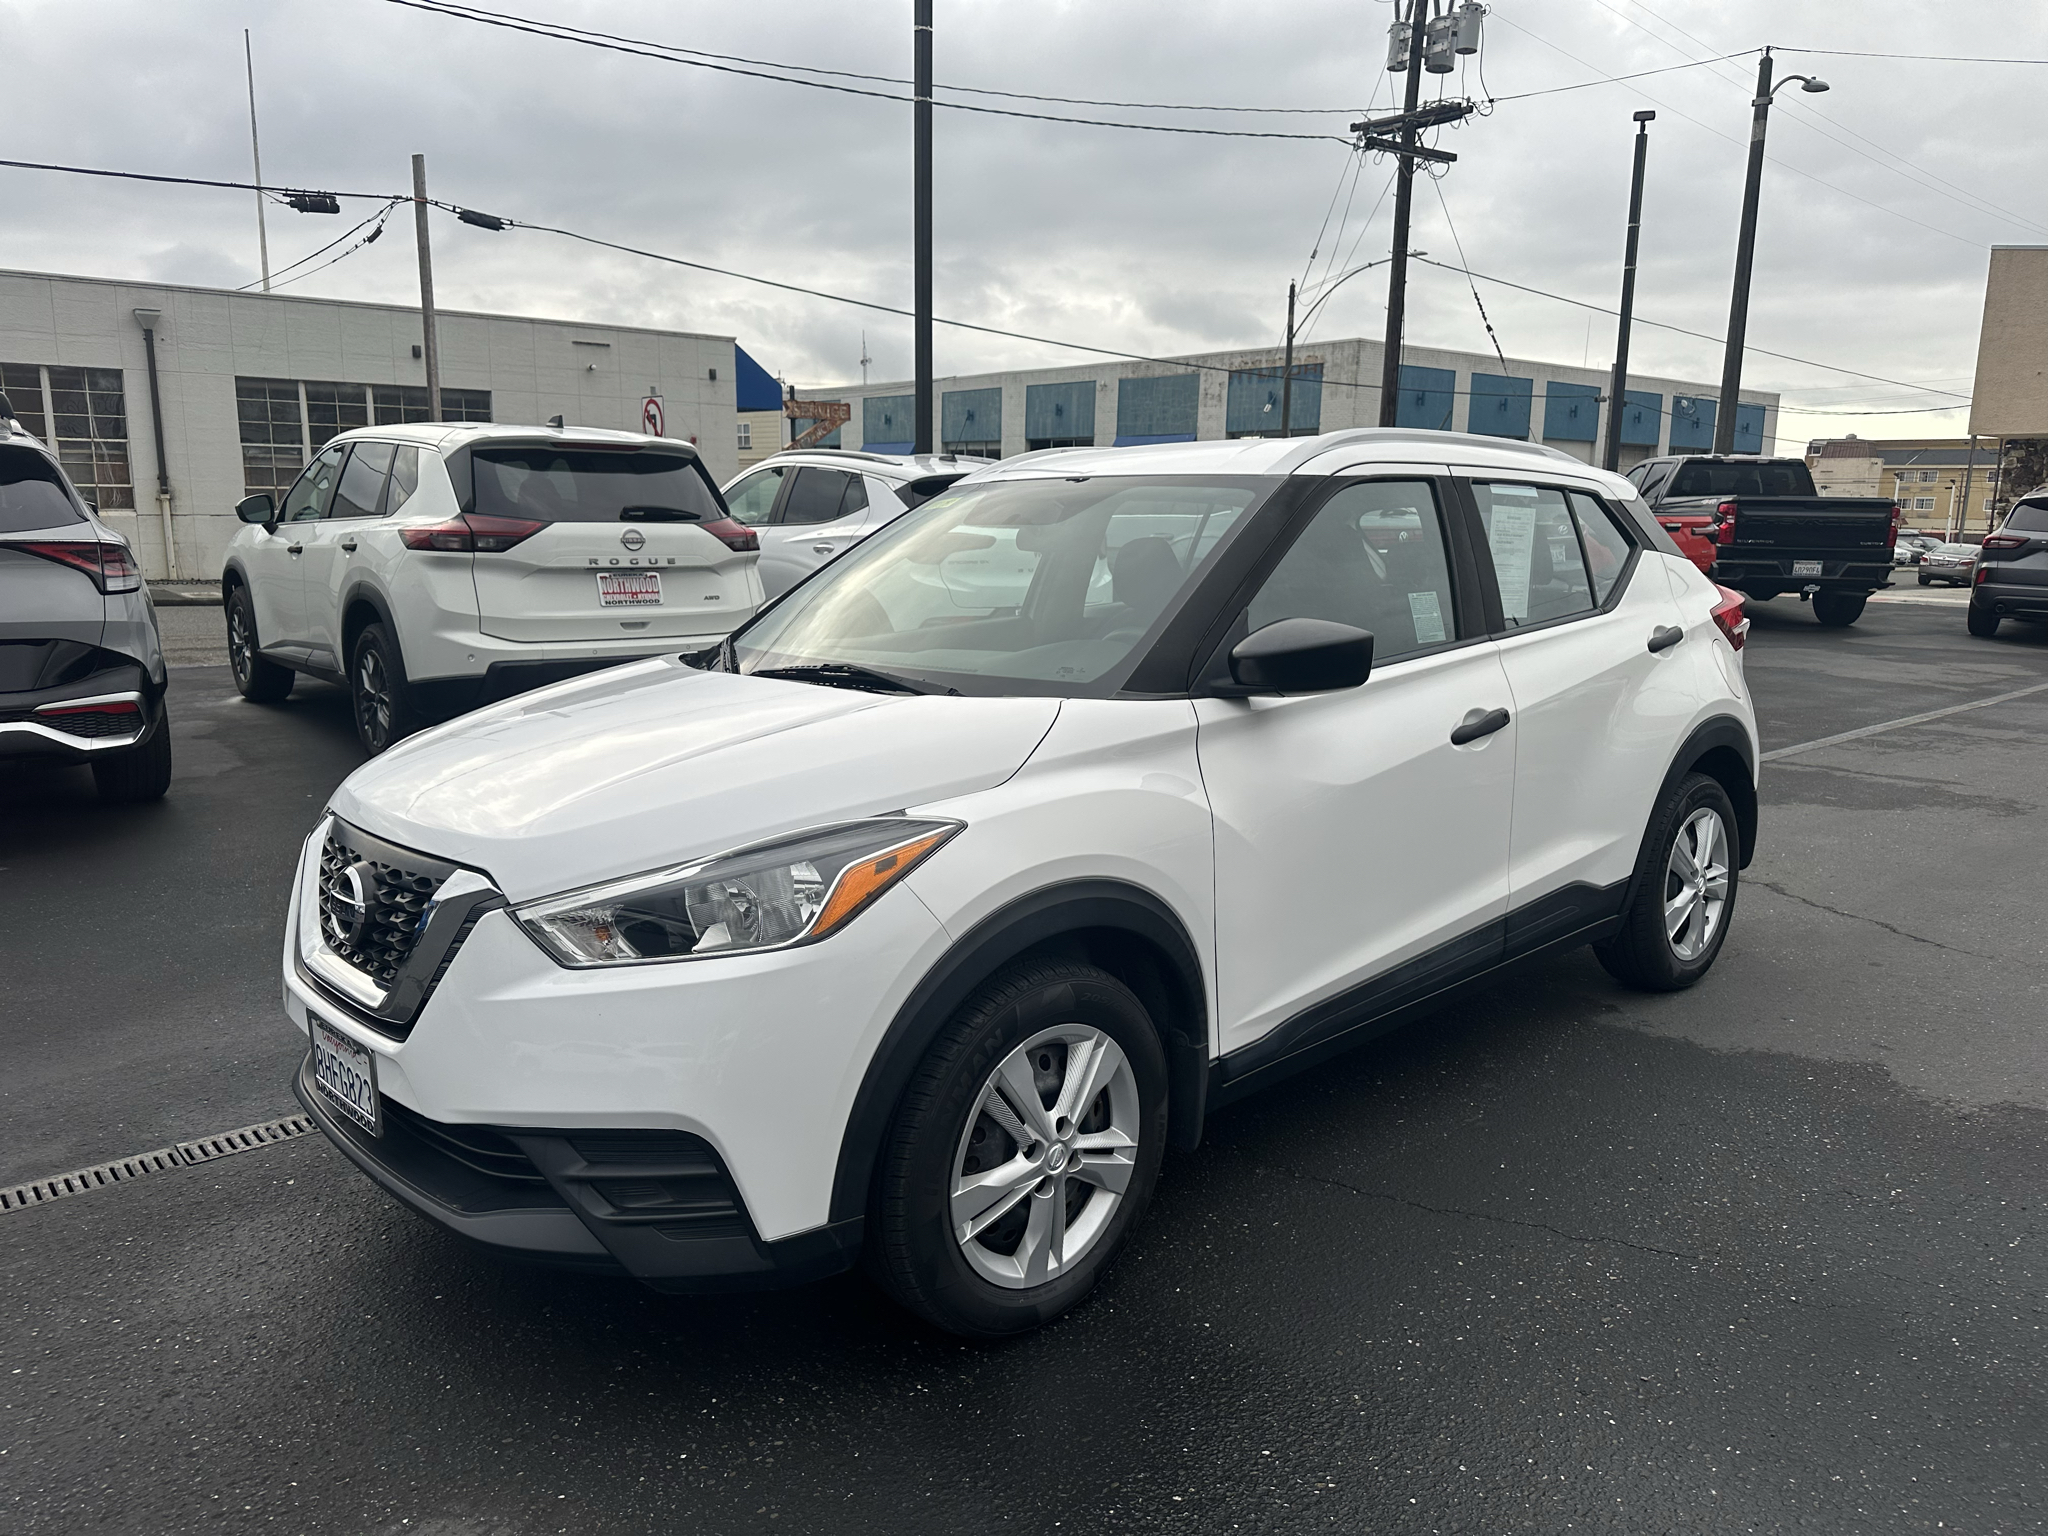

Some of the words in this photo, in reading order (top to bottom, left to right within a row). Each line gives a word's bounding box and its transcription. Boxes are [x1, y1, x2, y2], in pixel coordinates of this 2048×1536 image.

[793, 402, 848, 419] SERVICE
[588, 557, 676, 566] ROGUE
[601, 577, 659, 593] NORTHWOOD
[317, 1080, 374, 1132] NORTHWOOD
